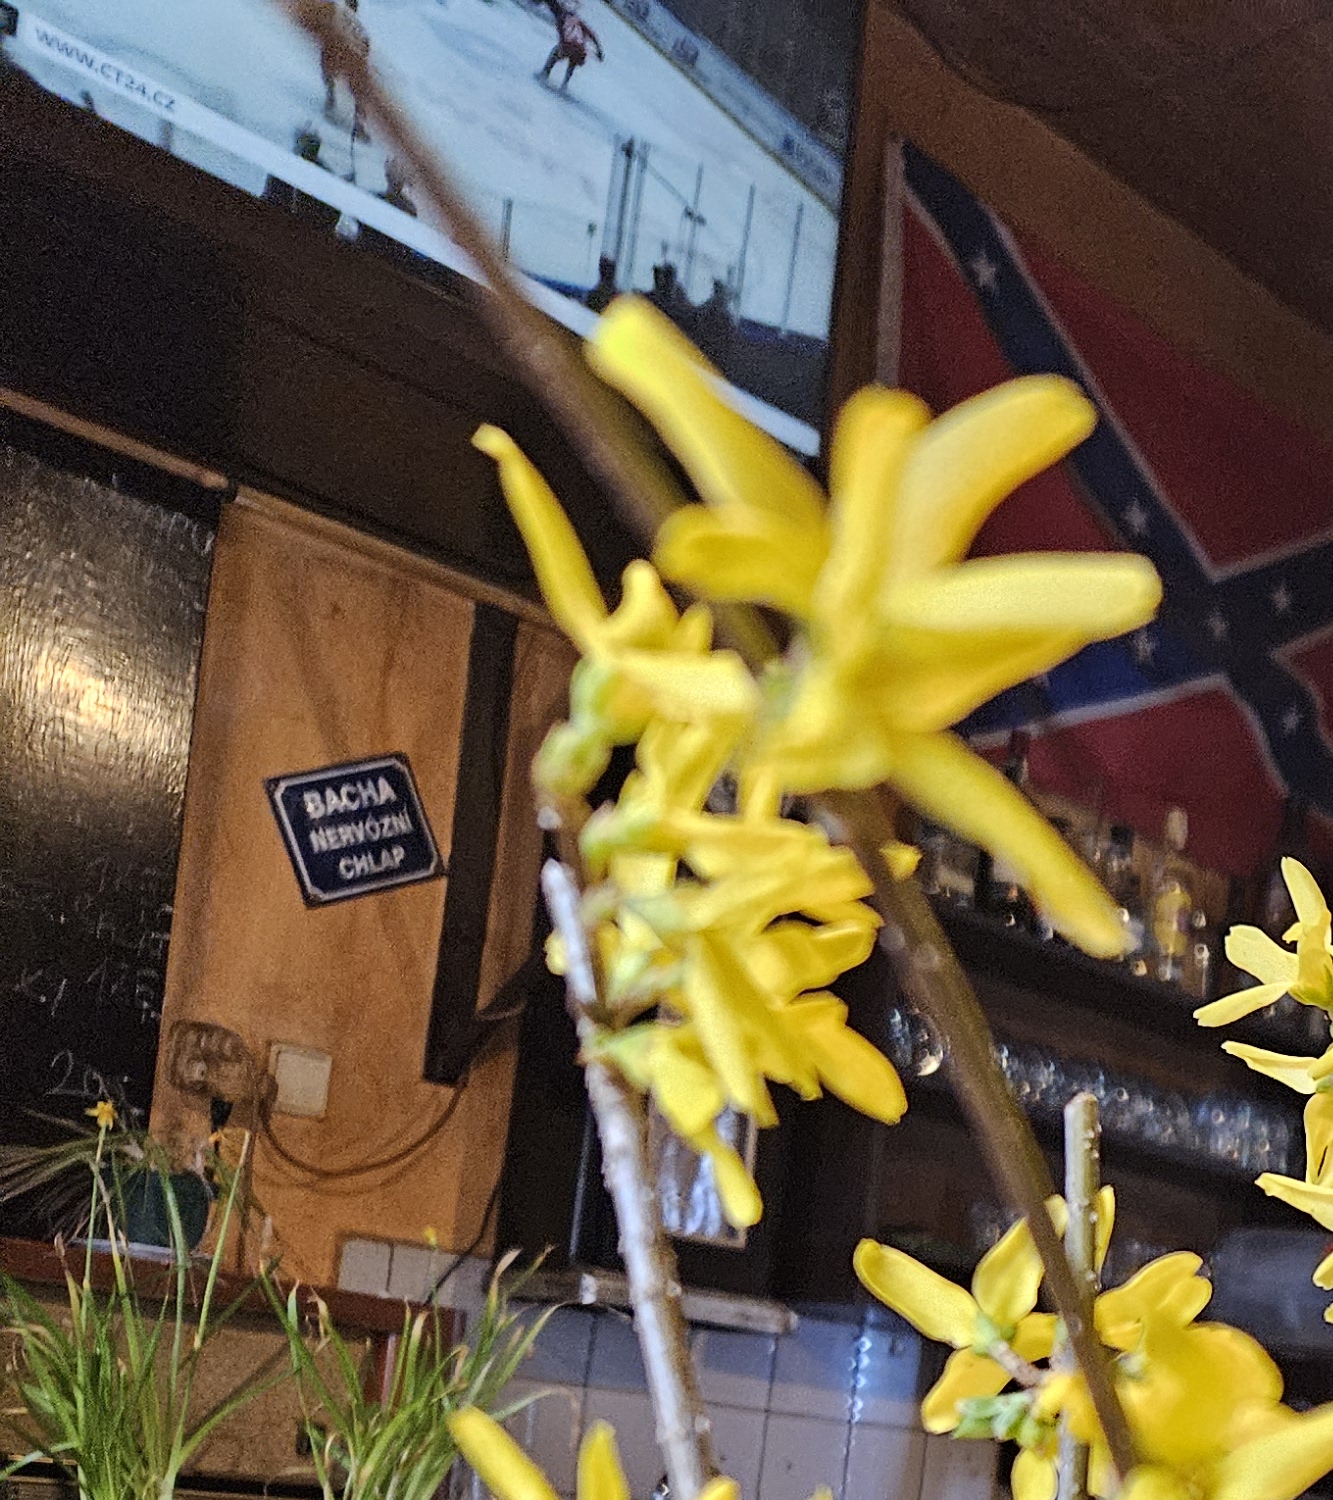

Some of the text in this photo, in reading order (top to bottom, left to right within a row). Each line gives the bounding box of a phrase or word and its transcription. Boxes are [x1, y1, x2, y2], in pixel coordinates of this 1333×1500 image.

[303, 776, 397, 820] BACHA
[308, 806, 414, 854] NERVÓZNÍ
[338, 845, 406, 880] CHLAP
